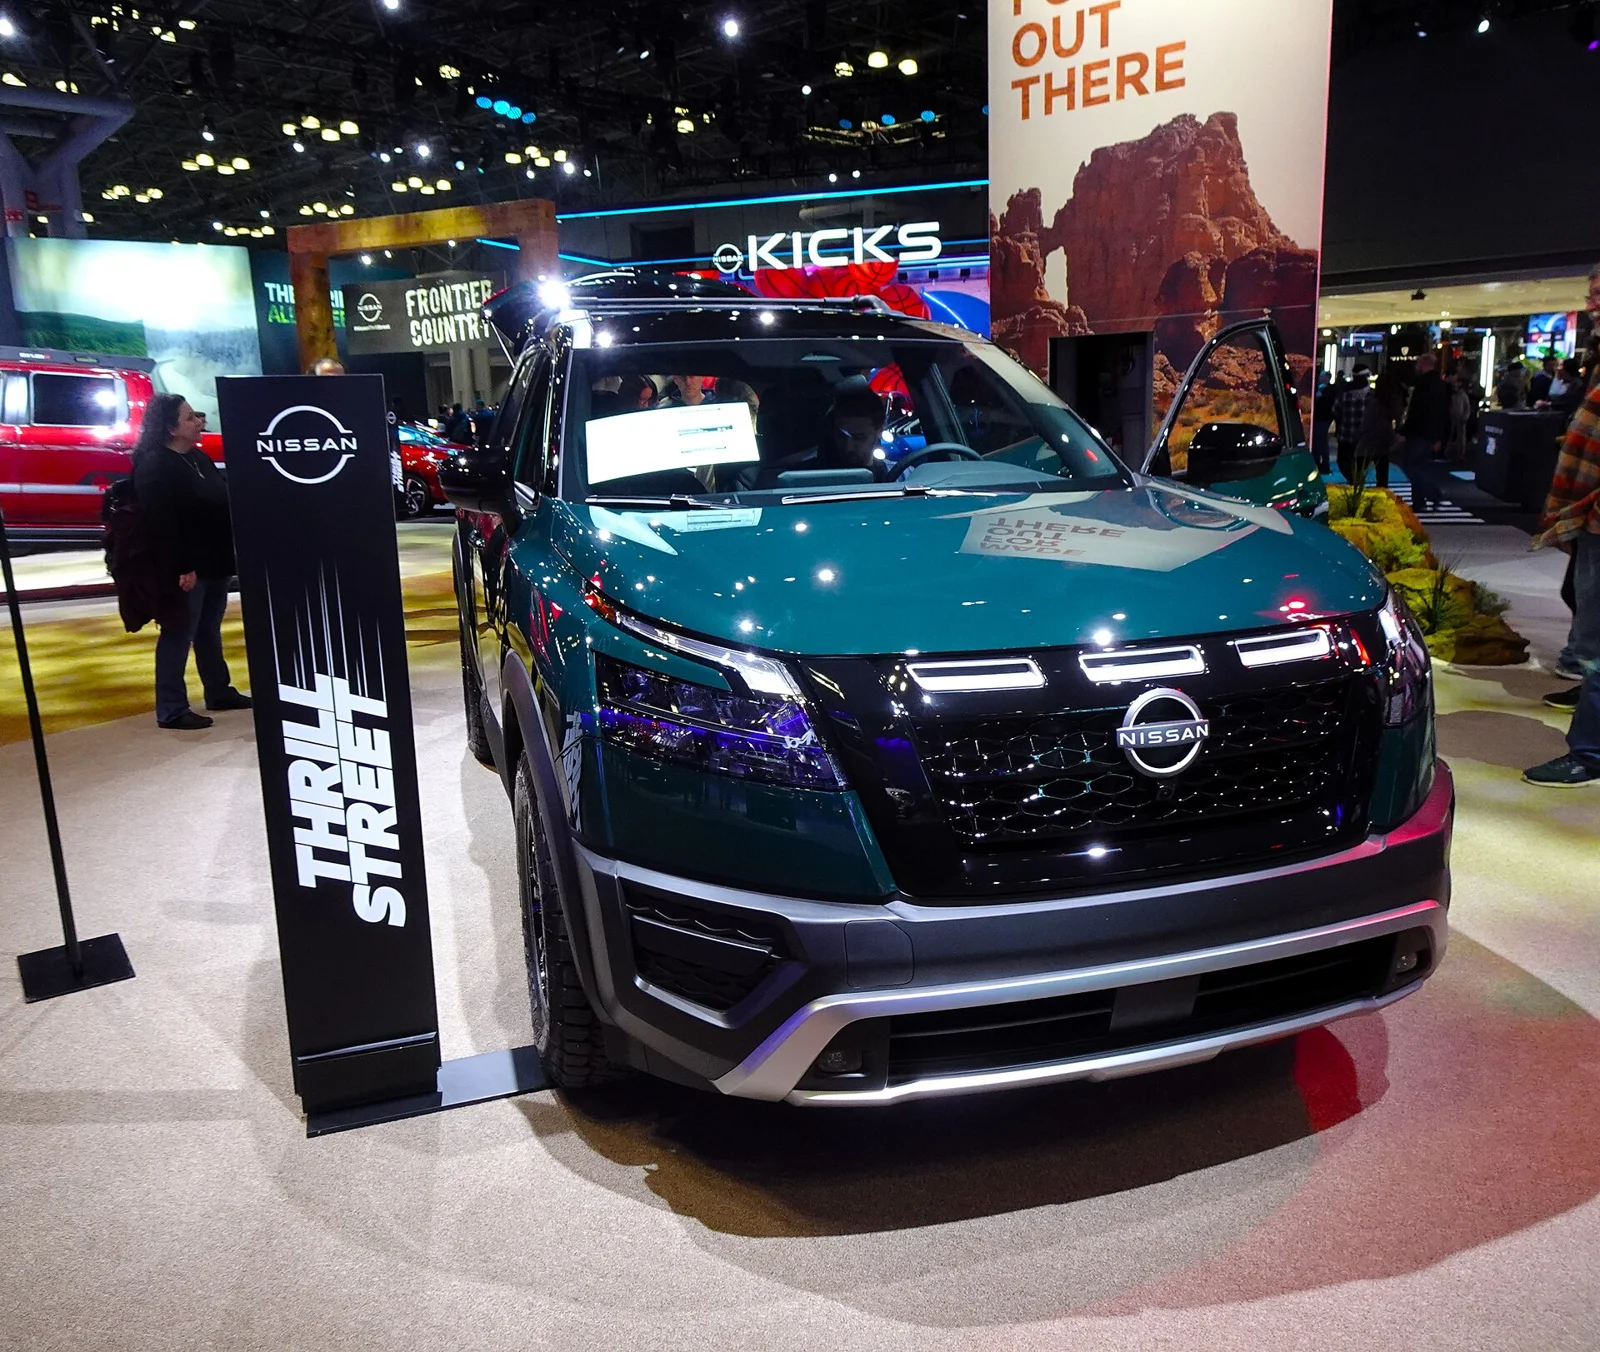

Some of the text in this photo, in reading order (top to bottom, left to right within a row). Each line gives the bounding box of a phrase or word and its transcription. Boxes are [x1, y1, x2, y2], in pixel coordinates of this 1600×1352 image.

[1012, 0, 1121, 68] OUT
[1011, 40, 1186, 120] THERE
[712, 254, 744, 263] NISSAN
[747, 221, 942, 272] KICKS
[405, 279, 492, 317] FRONTIER
[410, 312, 490, 347] COUNTRY
[256, 437, 358, 453] NISSAN
[1119, 723, 1209, 746] NISSAN
[278, 672, 351, 888] THRILL
[332, 676, 407, 927] STREET
